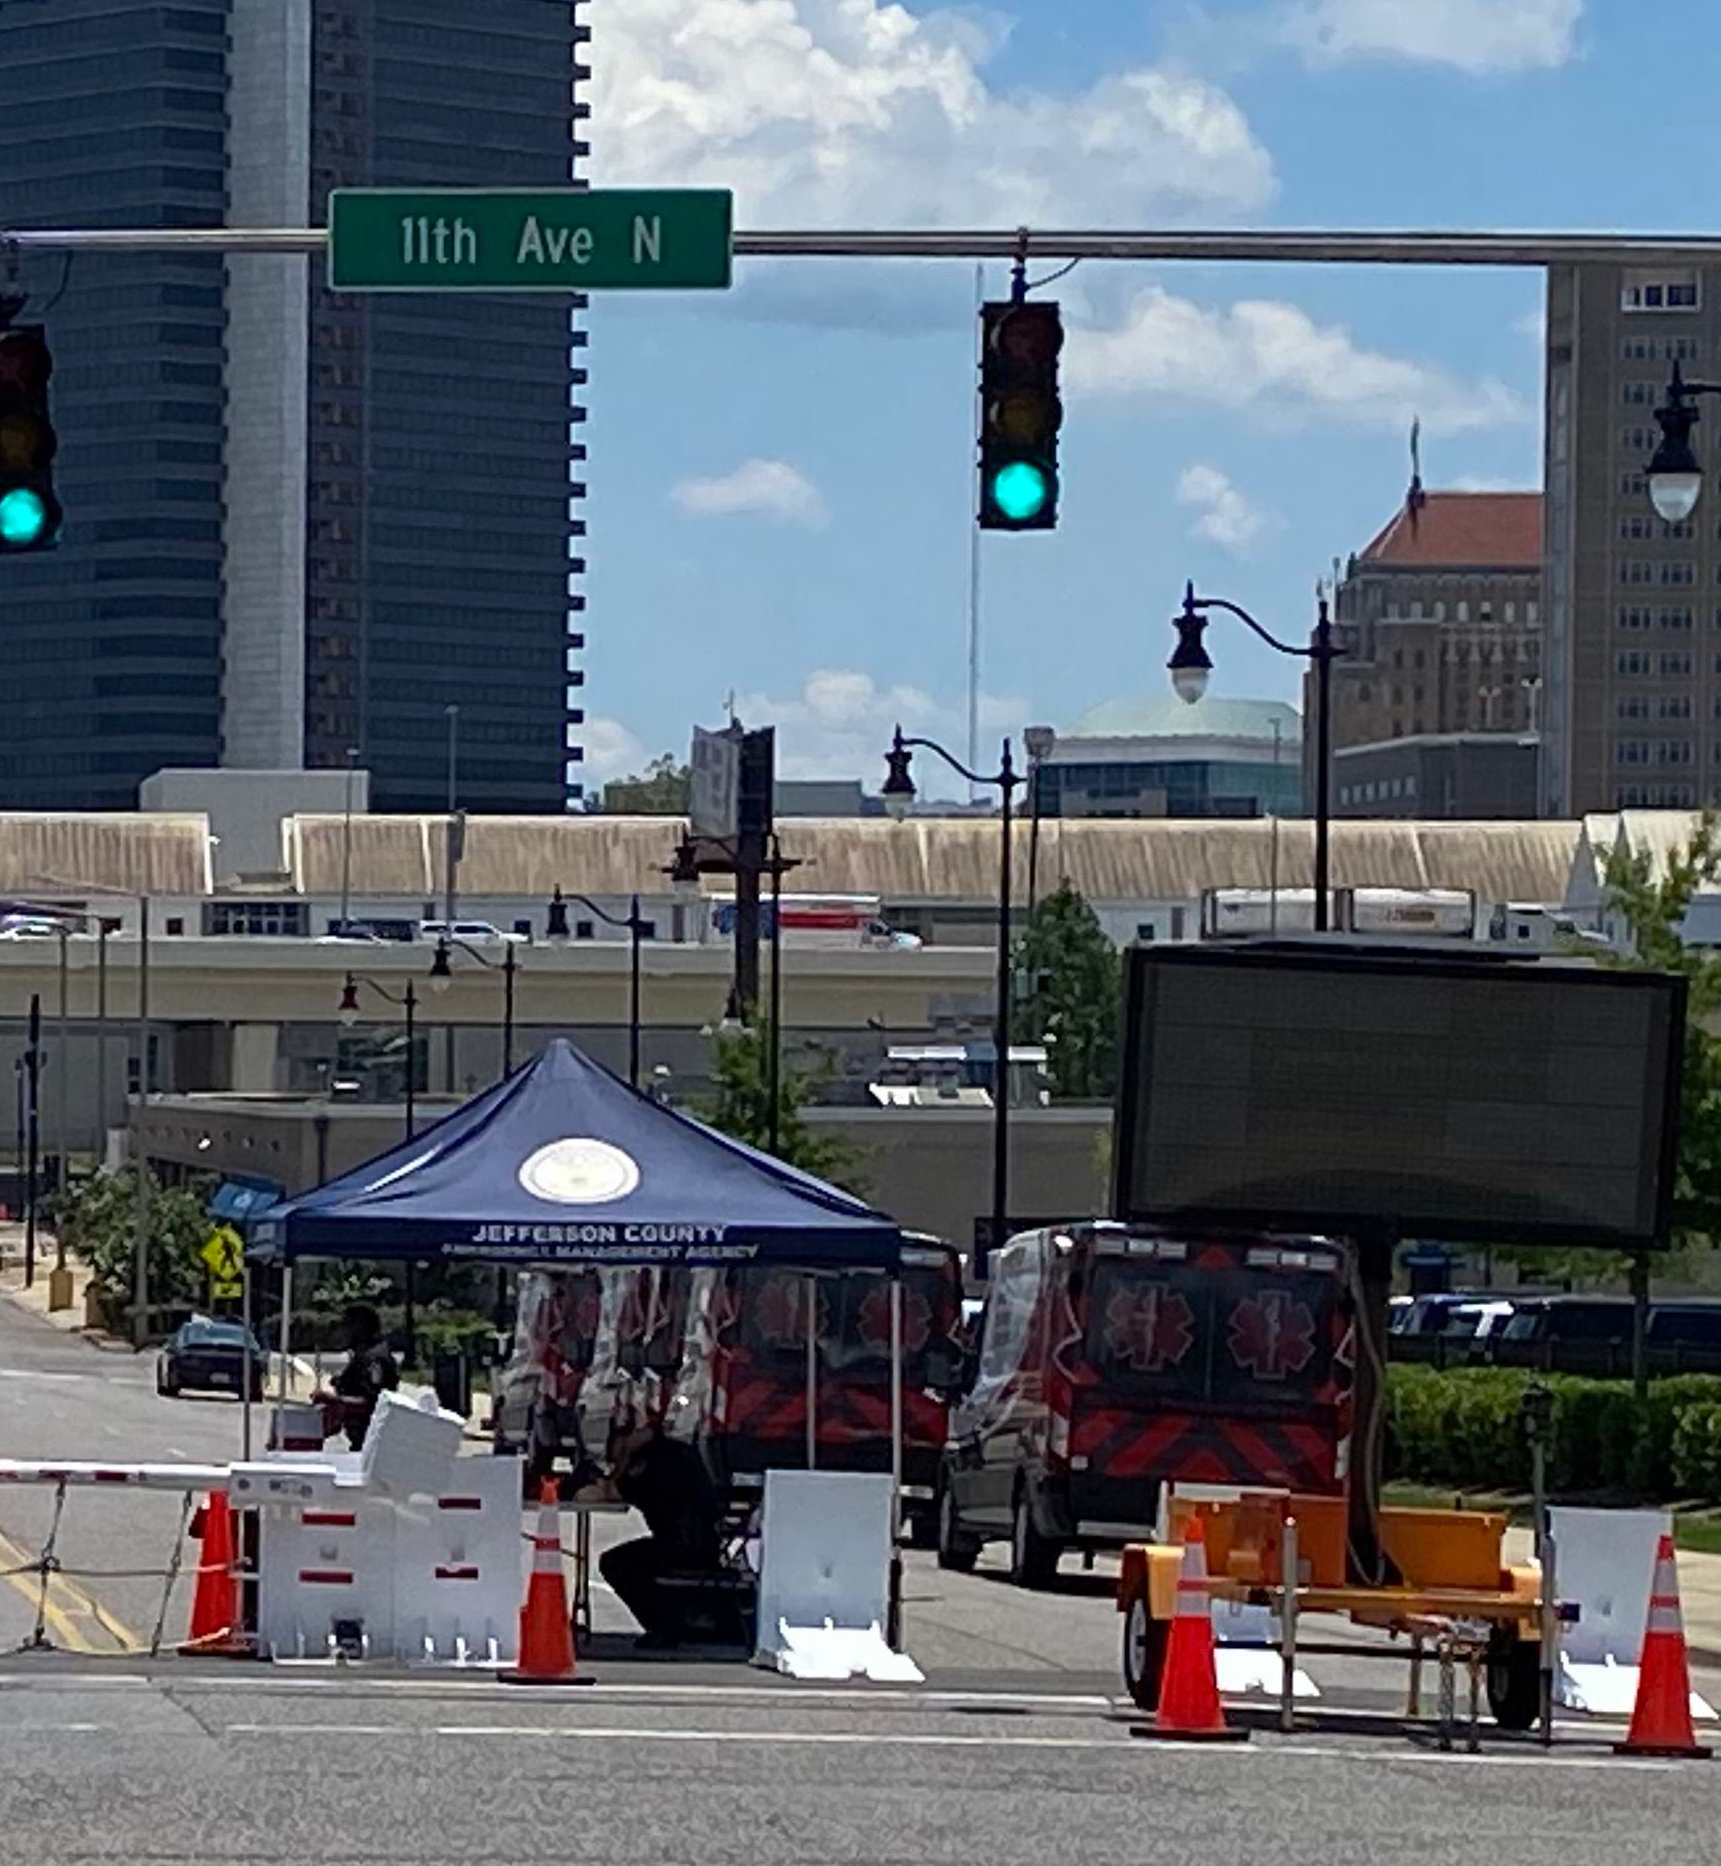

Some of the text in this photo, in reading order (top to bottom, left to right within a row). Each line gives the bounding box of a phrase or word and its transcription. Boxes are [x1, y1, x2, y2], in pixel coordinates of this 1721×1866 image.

[401, 215, 661, 264] 11th Ave N
[472, 1224, 729, 1243] JEFFERSON COUNTY
